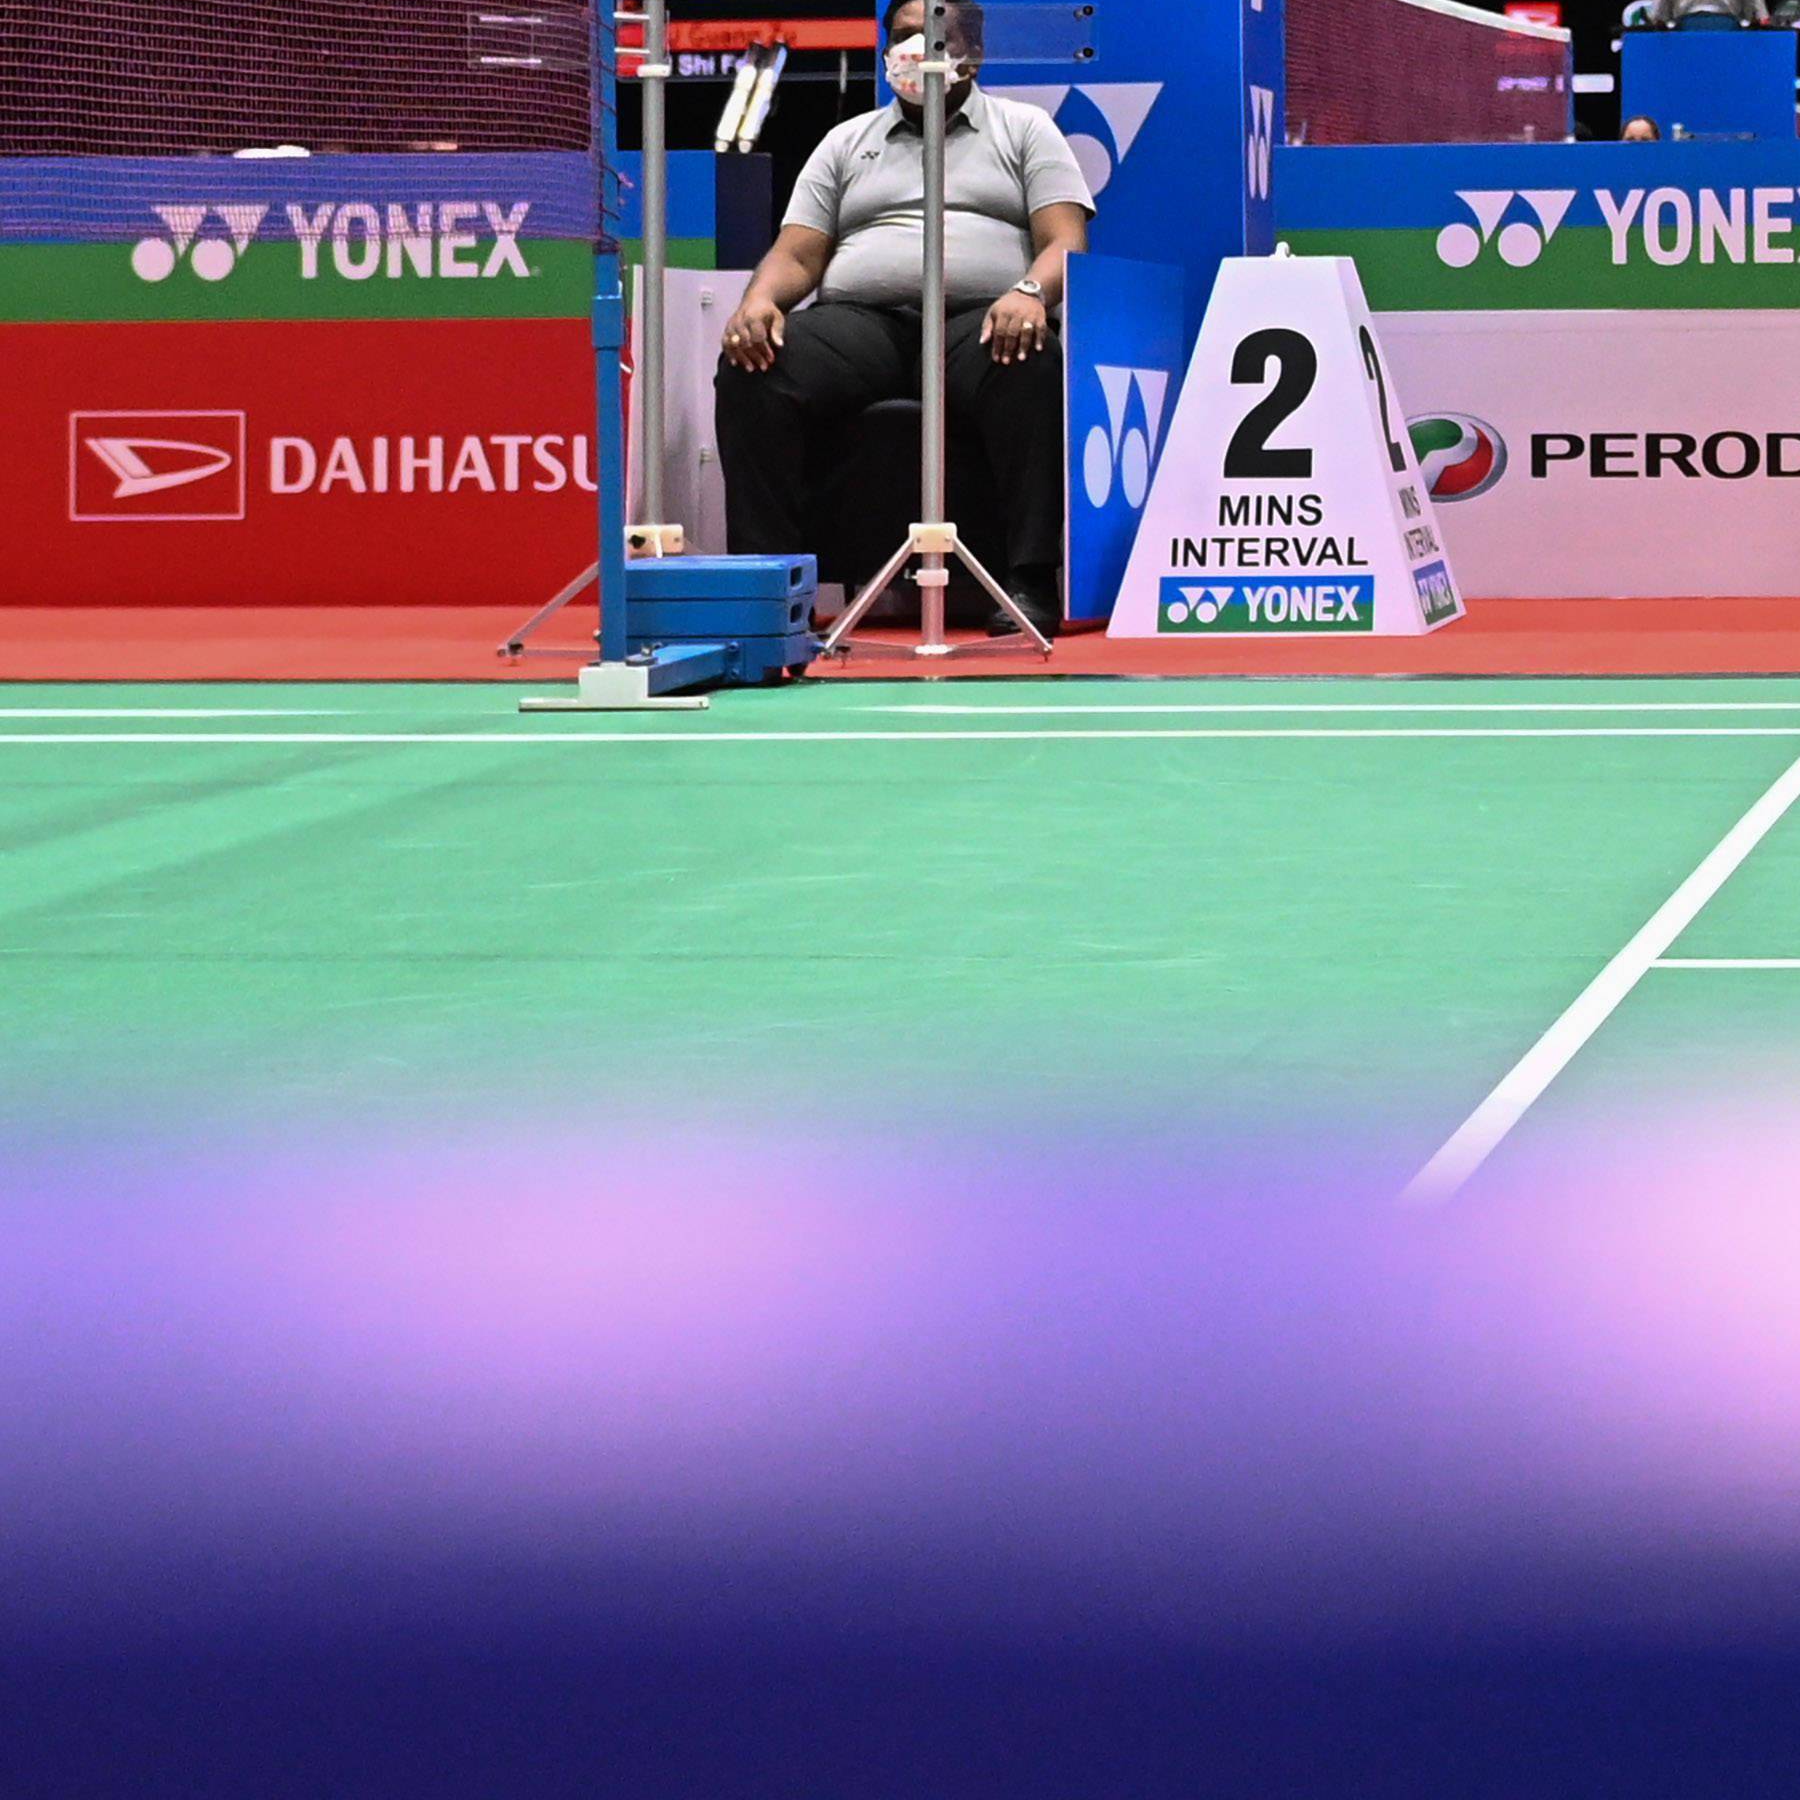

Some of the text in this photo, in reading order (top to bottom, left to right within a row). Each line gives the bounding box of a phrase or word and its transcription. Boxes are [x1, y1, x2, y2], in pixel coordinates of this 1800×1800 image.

[678, 53, 716, 76] Shi
[286, 202, 532, 279] YONEX
[1223, 327, 1318, 478] 2
[1359, 324, 1407, 472] 2
[1218, 494, 1324, 527] MINS
[1170, 536, 1369, 568] INTERVAL
[1242, 585, 1361, 623] YONEX
